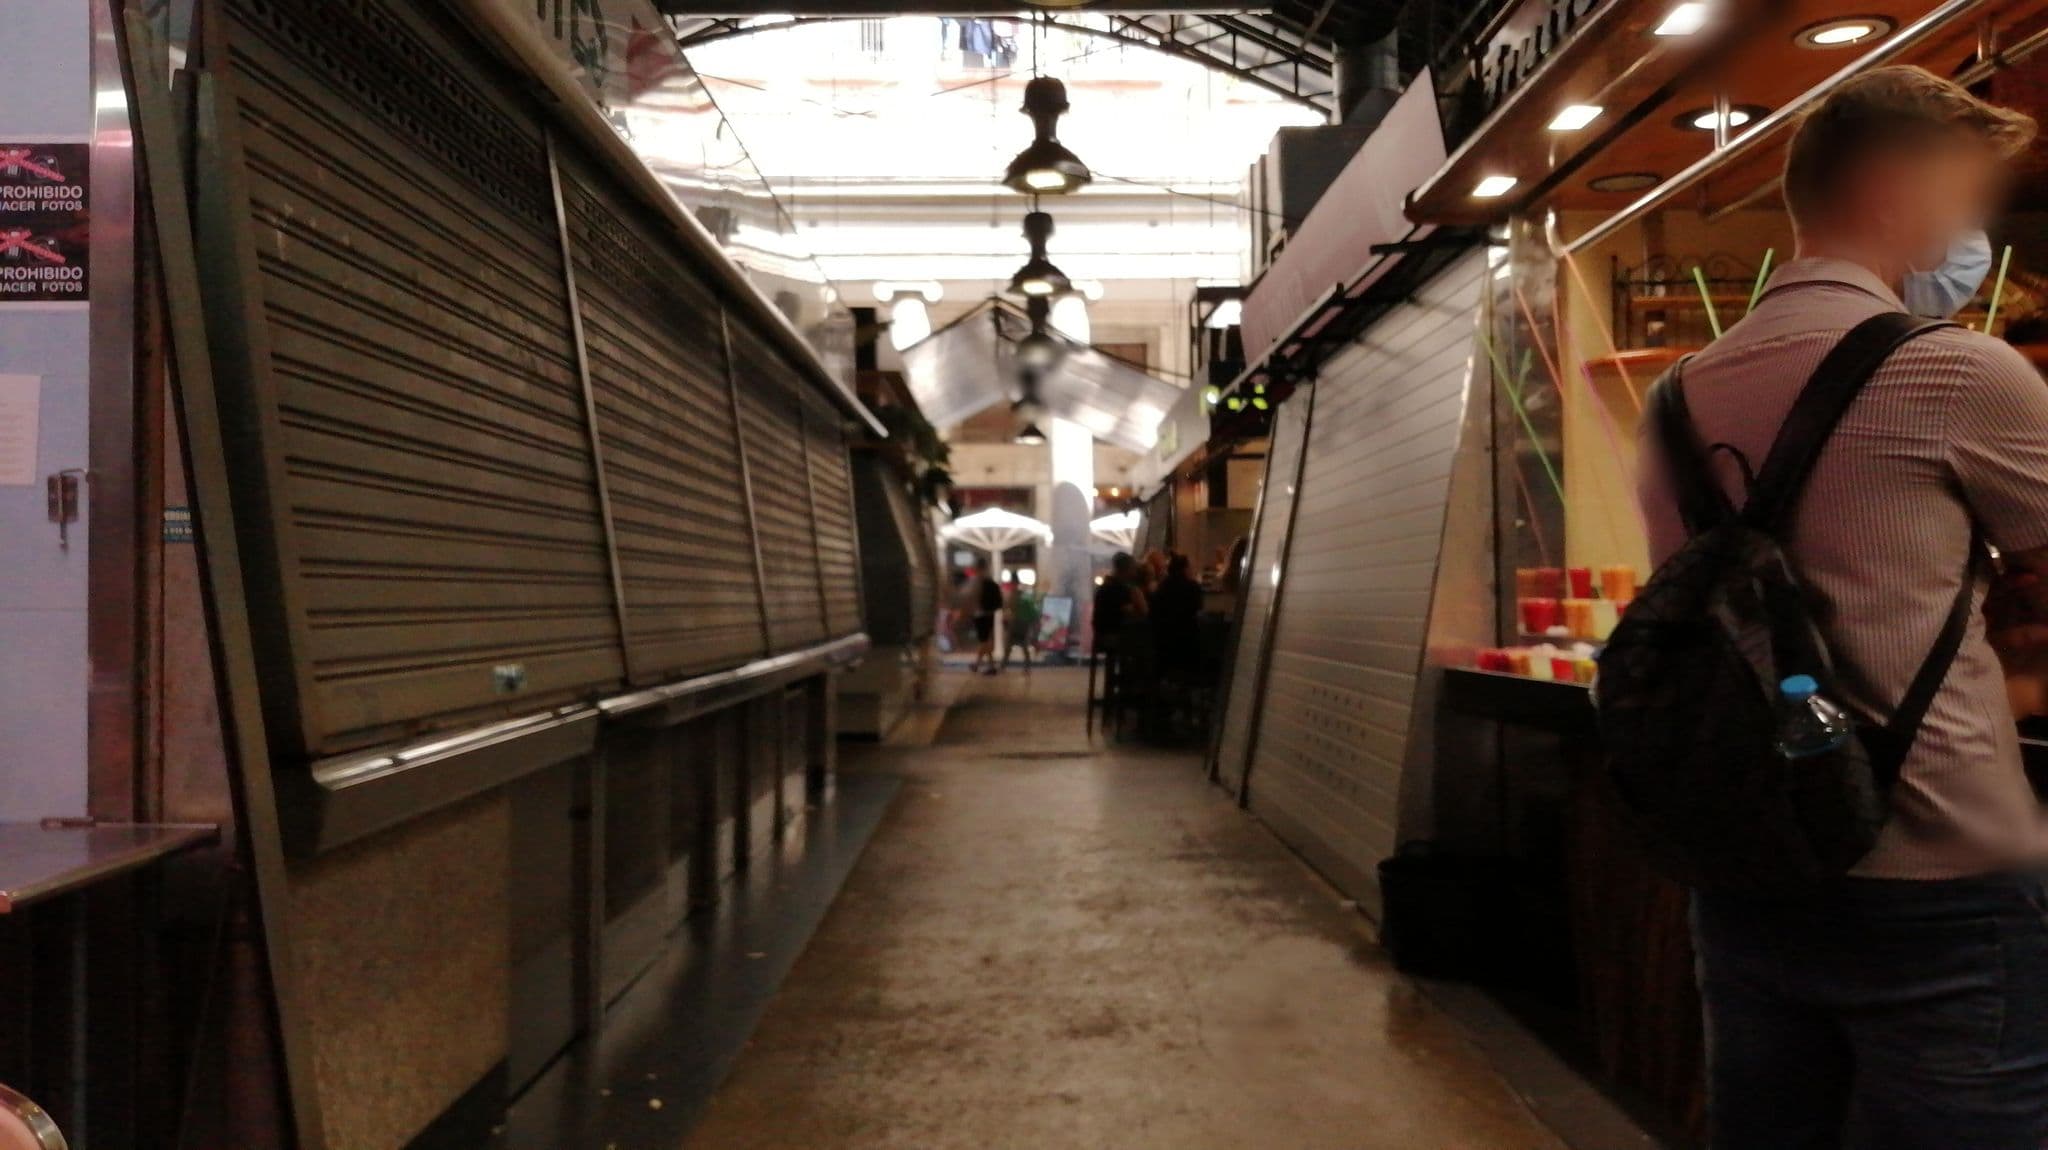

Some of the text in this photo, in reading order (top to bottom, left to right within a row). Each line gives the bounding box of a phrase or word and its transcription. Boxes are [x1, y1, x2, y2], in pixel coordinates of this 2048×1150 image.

[0, 185, 83, 199] ROHIBIDO
[0, 200, 83, 212] ACER FOTOS
[0, 281, 83, 293] ACER FOTOS
